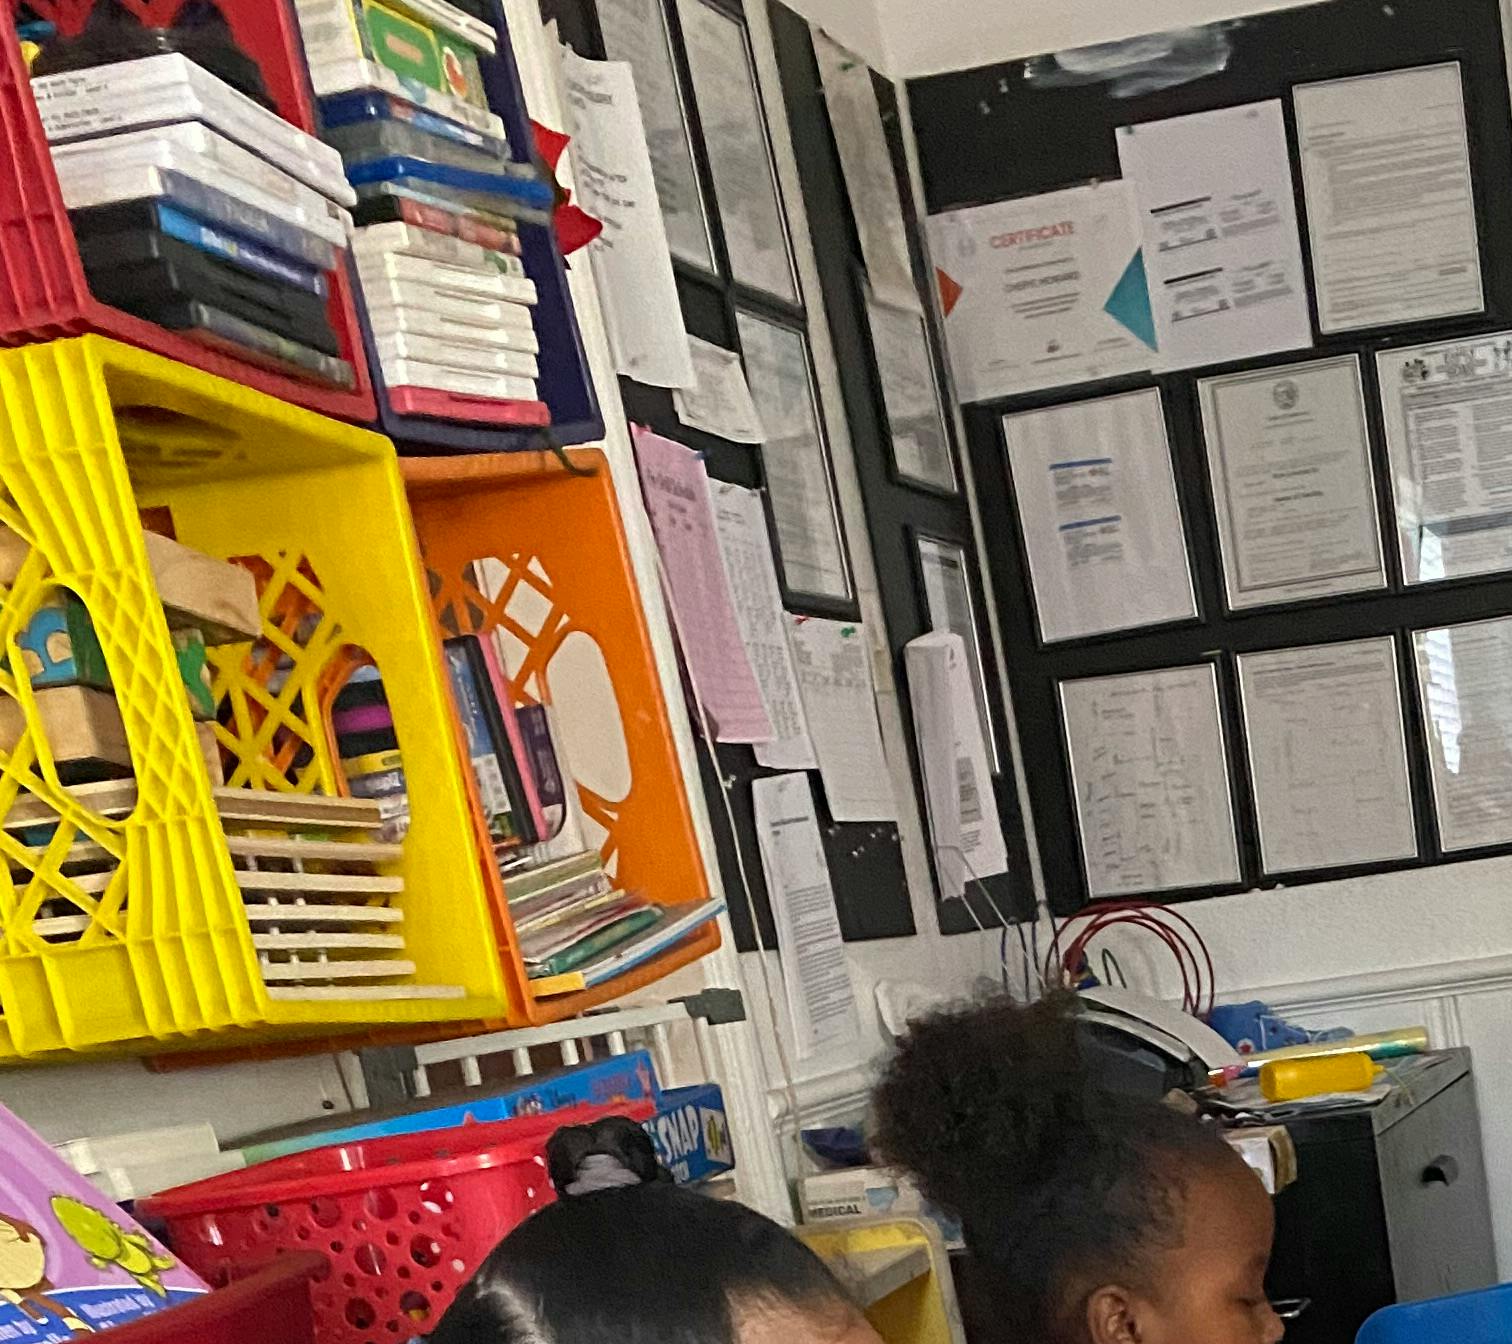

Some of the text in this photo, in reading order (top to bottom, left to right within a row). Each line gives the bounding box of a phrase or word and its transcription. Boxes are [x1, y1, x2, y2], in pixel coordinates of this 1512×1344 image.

[990, 221, 1075, 249] CERTIFICATE
[657, 1104, 700, 1164] SNAP
[808, 1203, 863, 1218] MEDICAL
